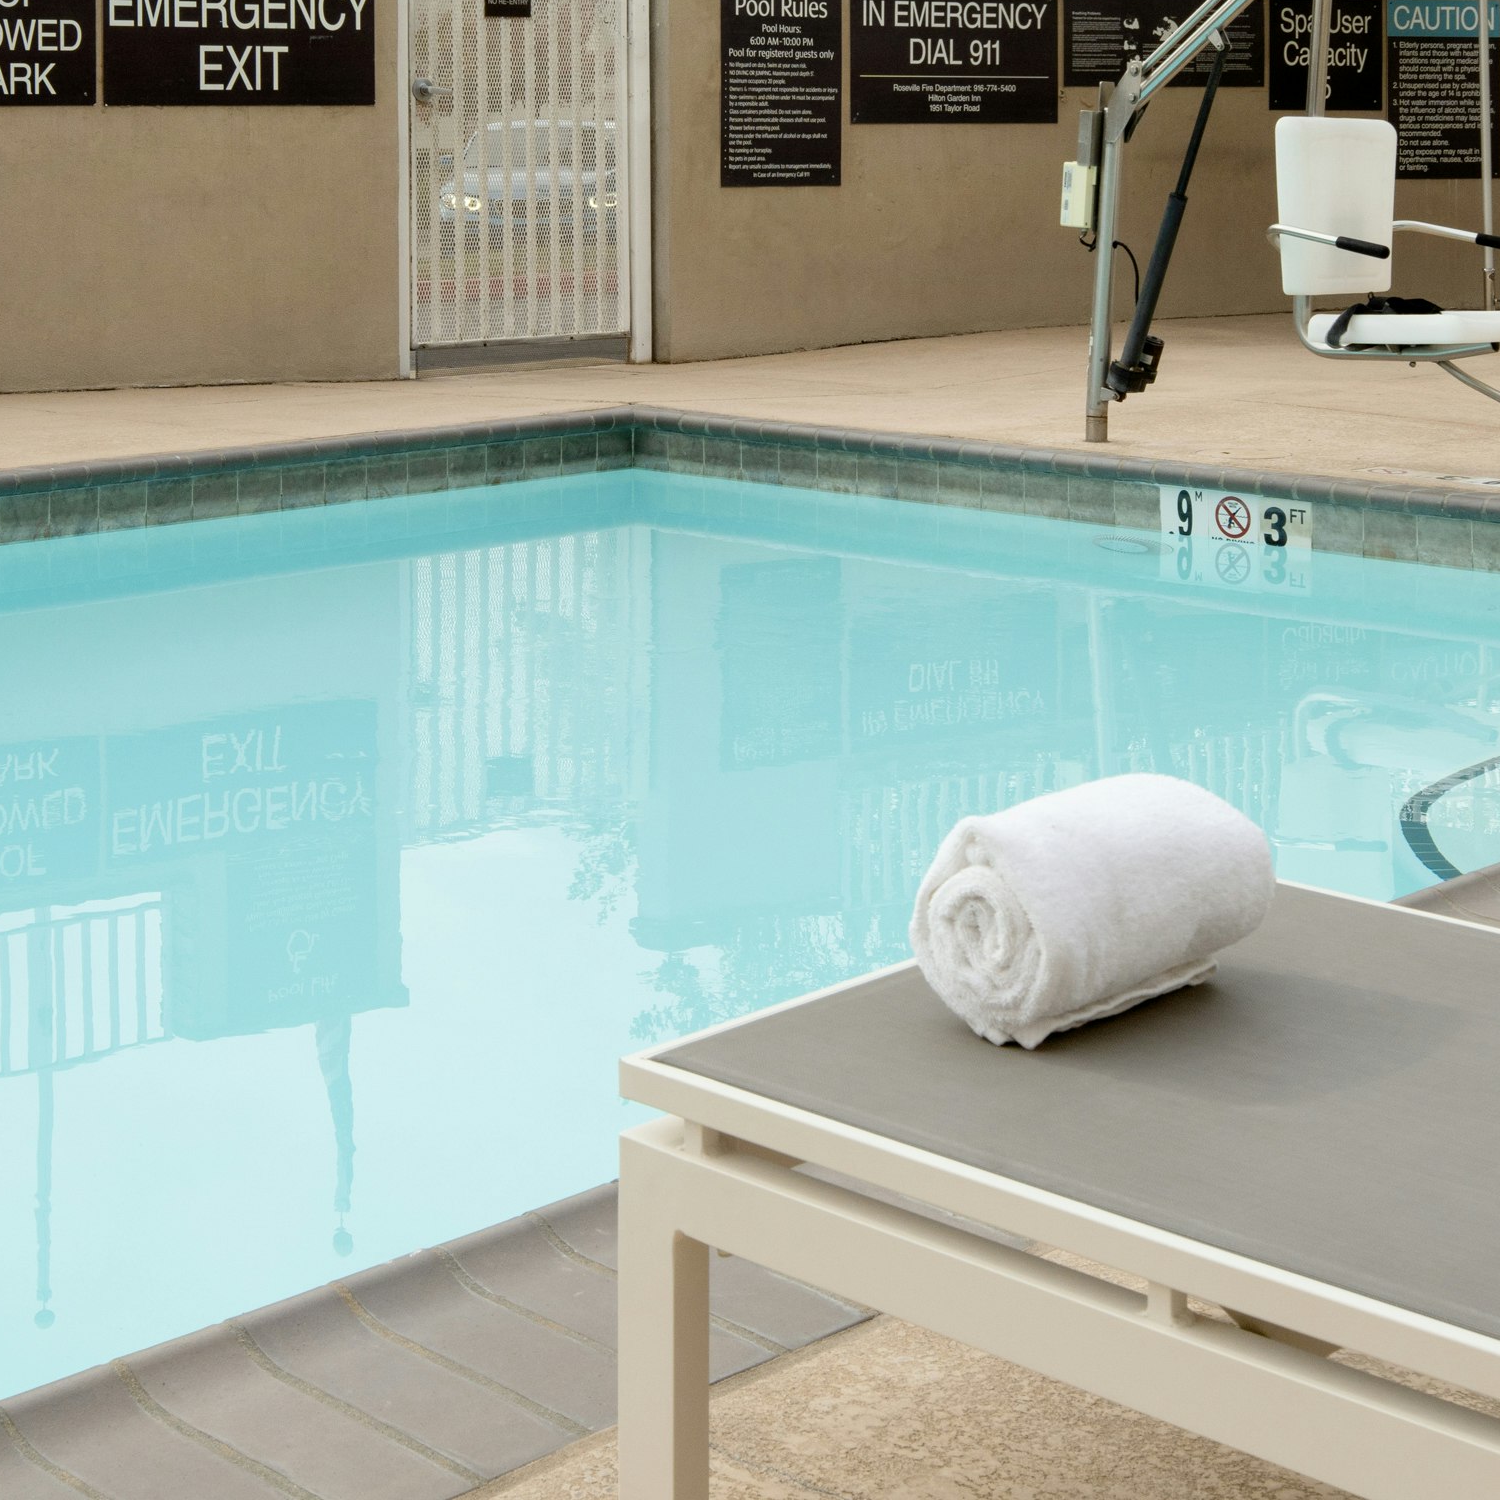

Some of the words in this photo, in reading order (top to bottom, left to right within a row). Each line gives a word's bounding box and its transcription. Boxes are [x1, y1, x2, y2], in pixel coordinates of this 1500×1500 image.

[863, 0, 885, 26] IN
[894, 0, 1047, 30] EMERGENCY
[762, 23, 778, 33] Pool
[779, 24, 801, 34] Hours:
[750, 36, 766, 45] 6:00
[802, 37, 814, 46] PM
[728, 48, 745, 57] Pool
[746, 48, 757, 57] for
[758, 48, 794, 60] registered
[794, 50, 818, 60] guests
[819, 49, 834, 60] only
[910, 38, 963, 65] DIAL
[970, 39, 1000, 66] 911
[1283, 41, 1368, 73] Caacity
[199, 45, 289, 91] EXIT
[893, 83, 921, 92] Roseville
[921, 84, 934, 92] Fire
[928, 94, 946, 102] Hilton
[947, 94, 970, 102] Garden
[971, 94, 981, 102] Inn
[929, 104, 943, 112] 1951
[943, 104, 962, 114] Taylor
[963, 104, 980, 112] Road
[1195, 491, 1202, 502] M
[1263, 507, 1287, 547] 3
[1290, 509, 1306, 524] FT
